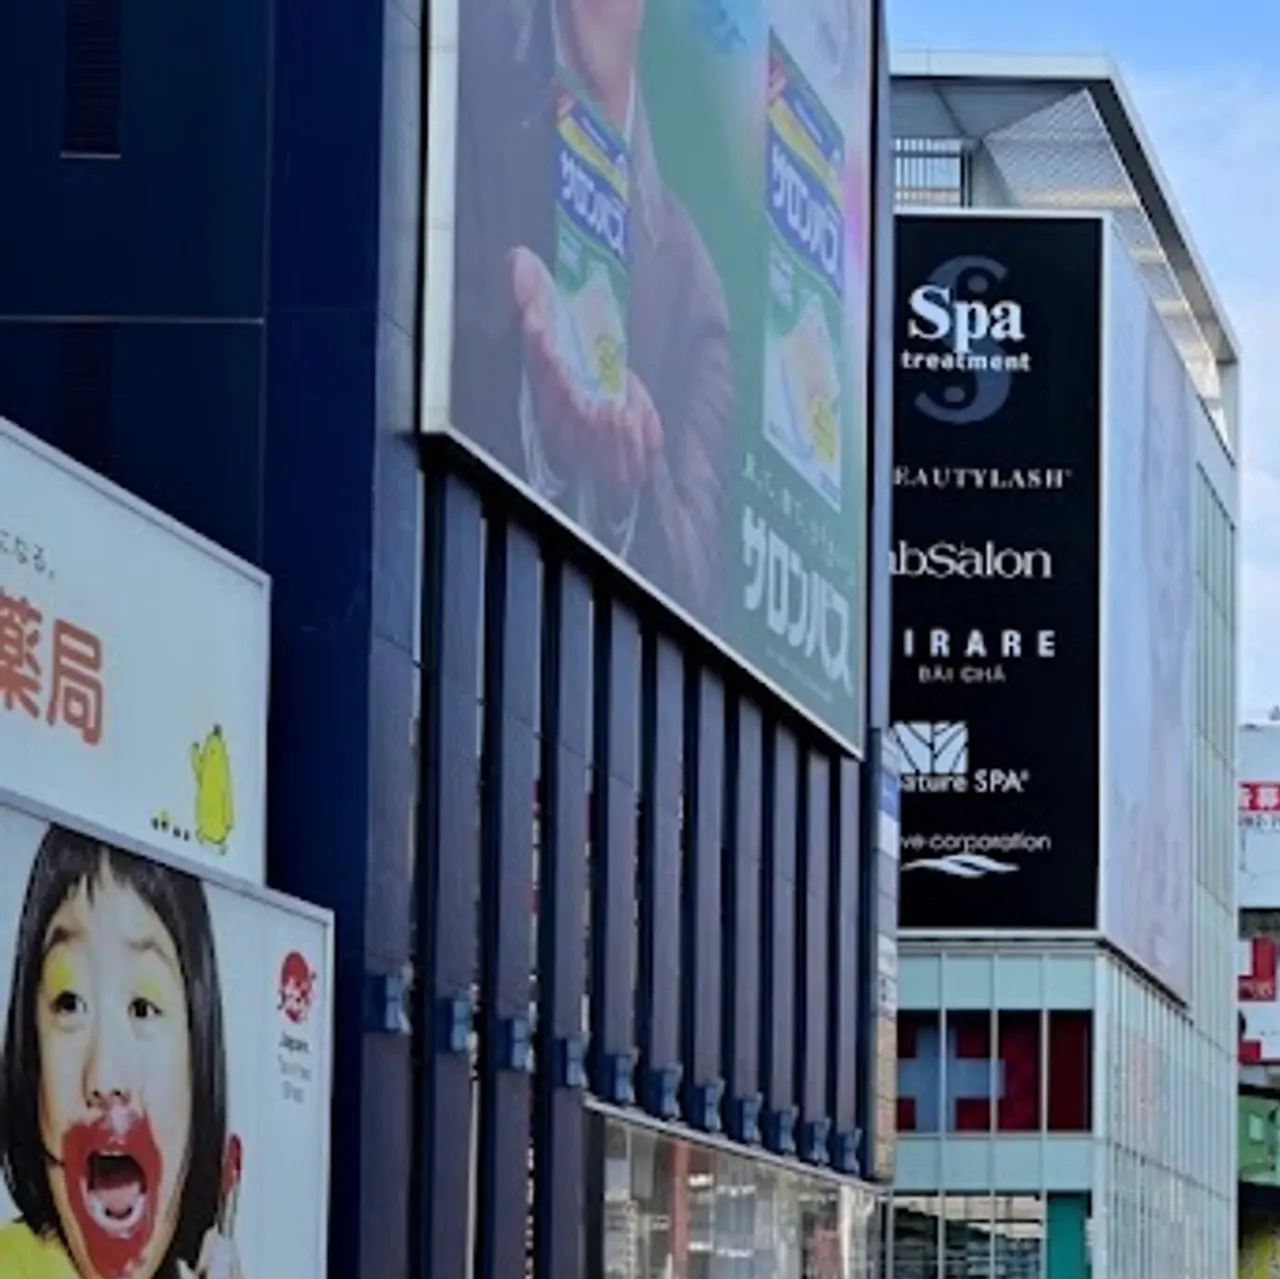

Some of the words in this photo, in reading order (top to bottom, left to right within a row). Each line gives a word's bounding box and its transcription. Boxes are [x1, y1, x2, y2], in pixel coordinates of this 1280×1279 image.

[907, 284, 1026, 352] Spa
[901, 350, 1032, 372] treatment
[741, 504, 853, 698] サロンパス
[973, 768, 1030, 793] SPA
